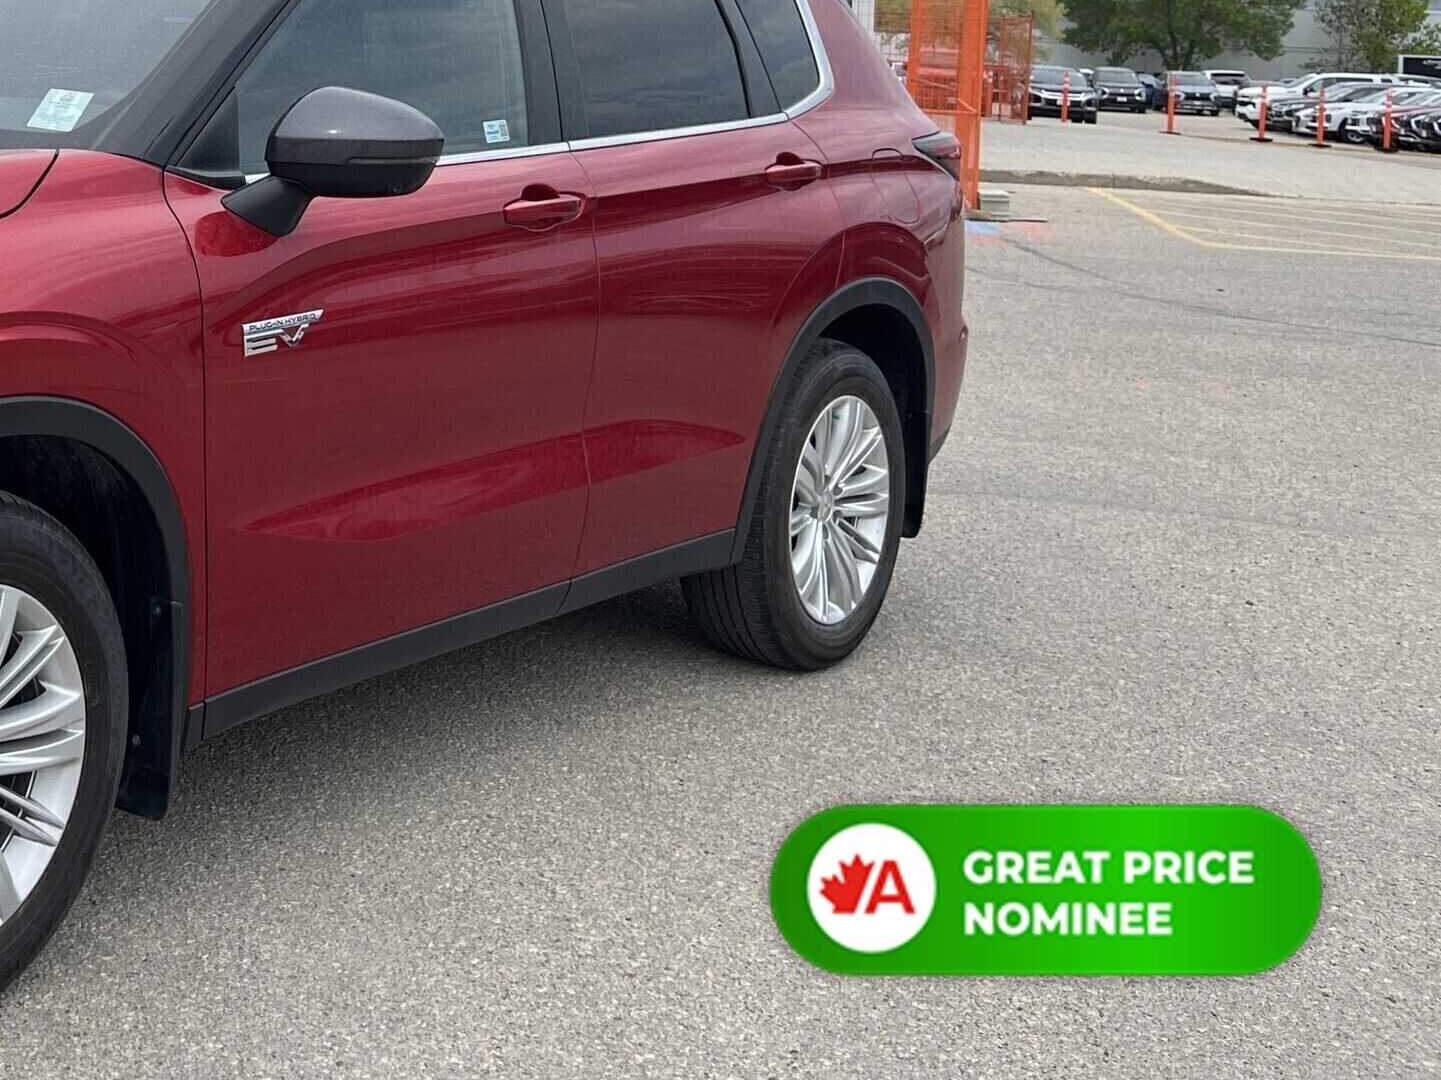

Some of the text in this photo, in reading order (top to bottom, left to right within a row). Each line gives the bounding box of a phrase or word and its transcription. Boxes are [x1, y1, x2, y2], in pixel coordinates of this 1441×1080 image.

[249, 313, 316, 331] PLUG-IN HYBRID
[244, 324, 309, 357] EV
